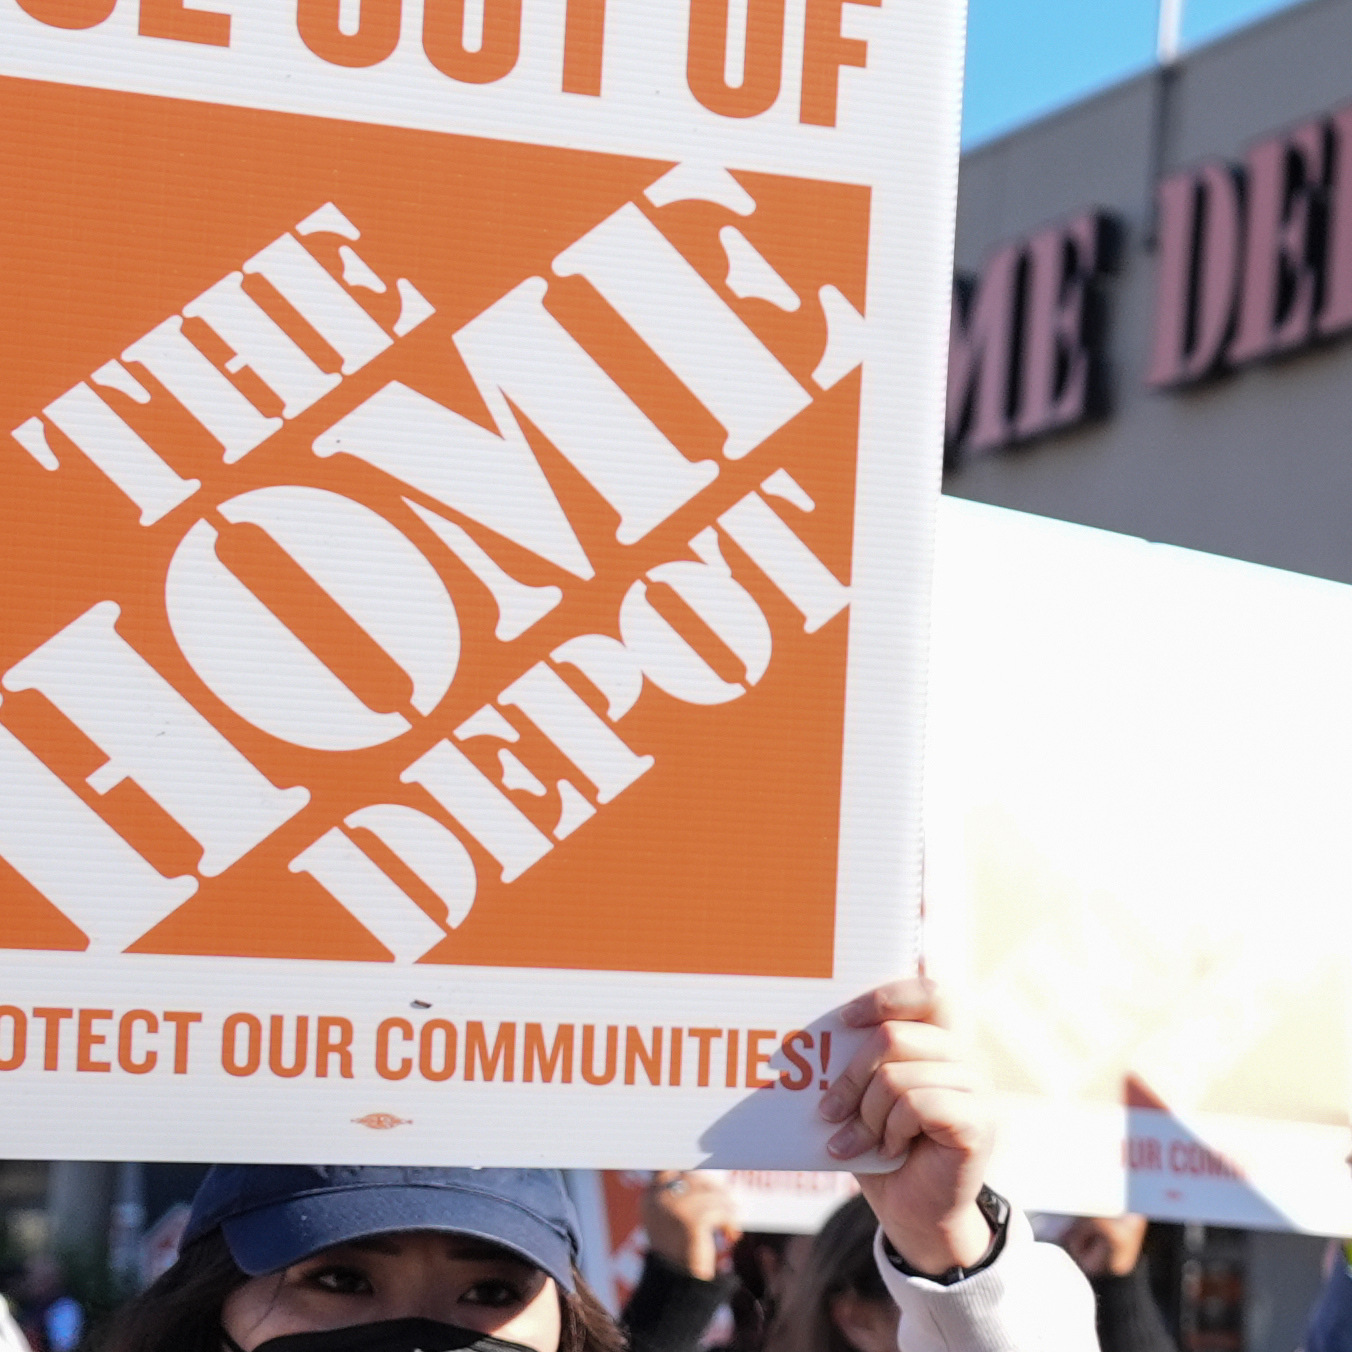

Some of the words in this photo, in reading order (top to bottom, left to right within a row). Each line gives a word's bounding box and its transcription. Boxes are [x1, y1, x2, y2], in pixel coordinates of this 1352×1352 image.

[0, 160, 866, 953] HOME
[10, 200, 437, 527] THE
[288, 467, 852, 964] DEPOT
[221, 1011, 356, 1080] OUR
[375, 1017, 832, 1093] COMMUNITIES!
